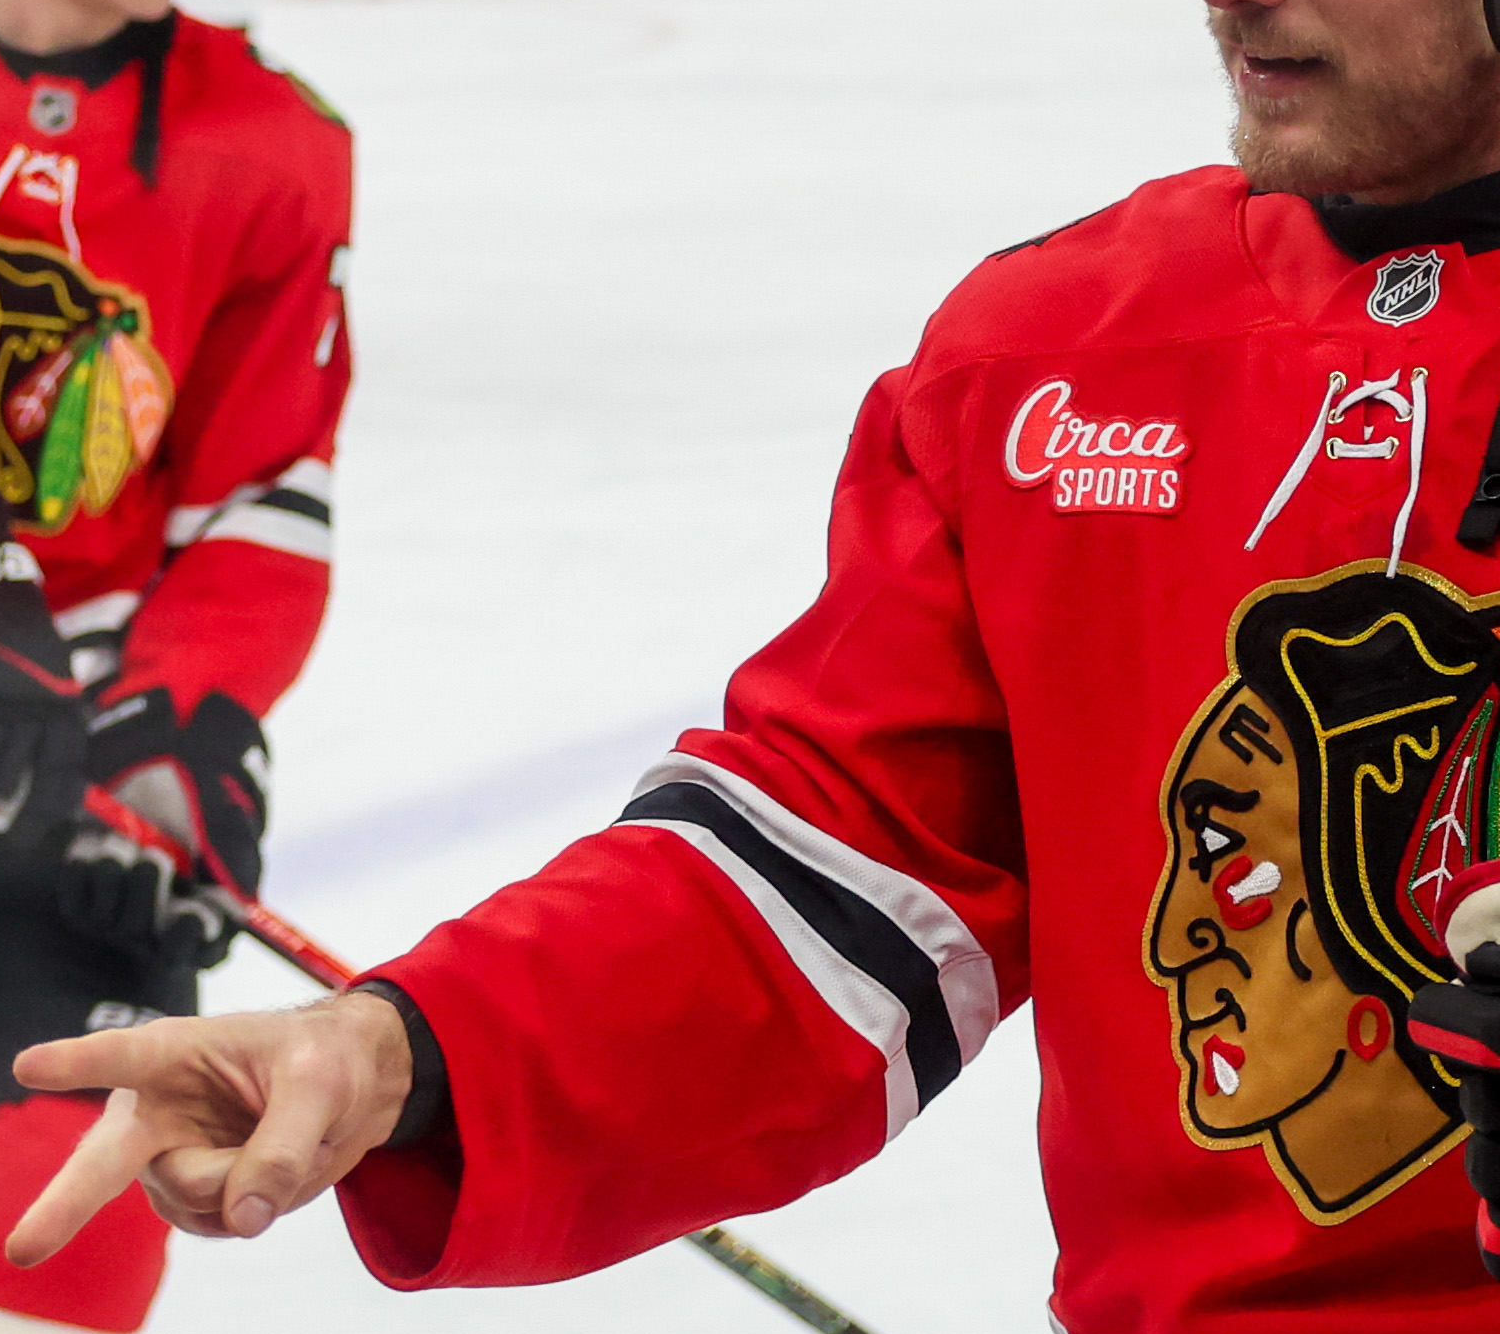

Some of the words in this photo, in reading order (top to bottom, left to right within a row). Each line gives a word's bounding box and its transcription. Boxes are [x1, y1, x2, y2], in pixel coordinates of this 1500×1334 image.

[1383, 271, 1428, 312] NHL
[1005, 380, 1186, 481] Circa
[1056, 467, 1179, 508] SPORTS
